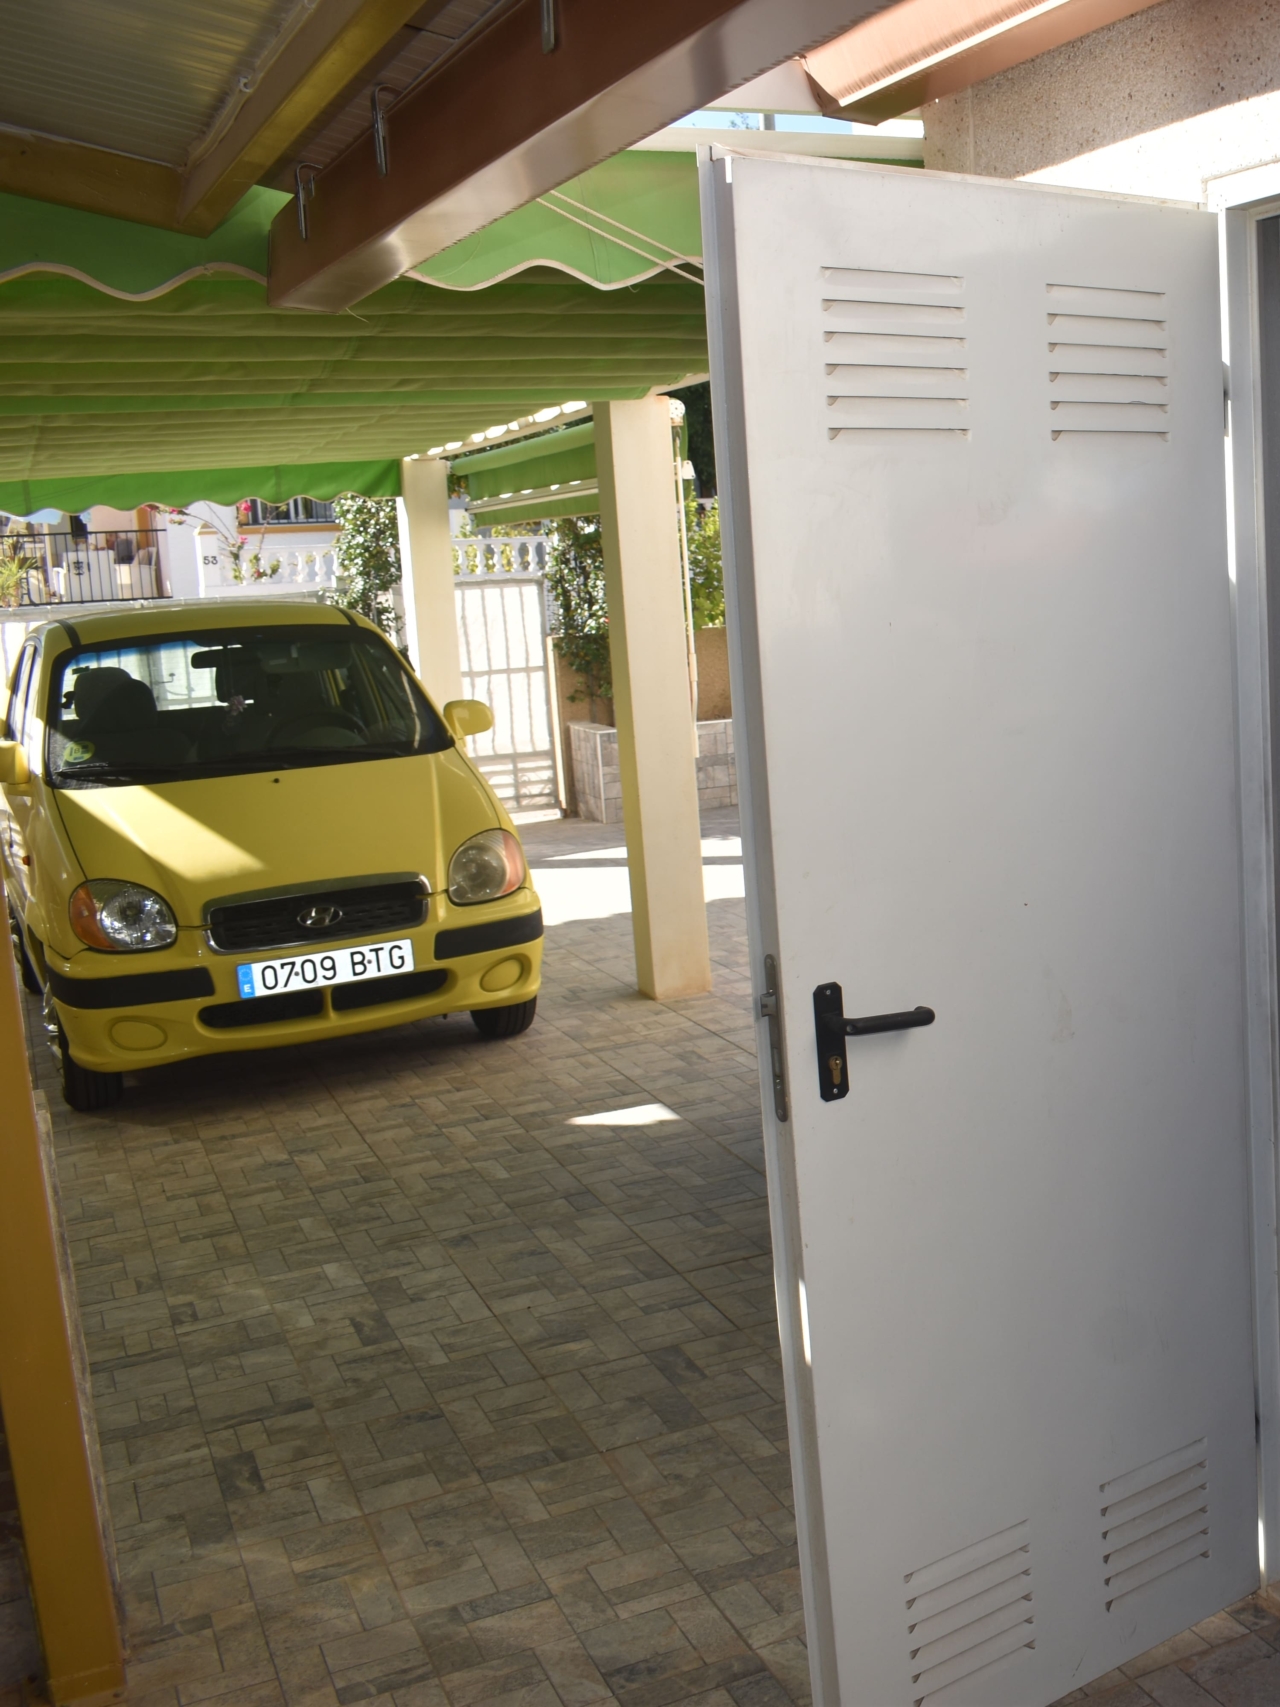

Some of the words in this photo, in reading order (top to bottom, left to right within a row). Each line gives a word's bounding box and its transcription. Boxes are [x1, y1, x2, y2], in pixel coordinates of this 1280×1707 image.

[203, 555, 219, 566] 53
[261, 955, 337, 991] 0709
[349, 944, 406, 977] BTG
[243, 984, 253, 993] E
